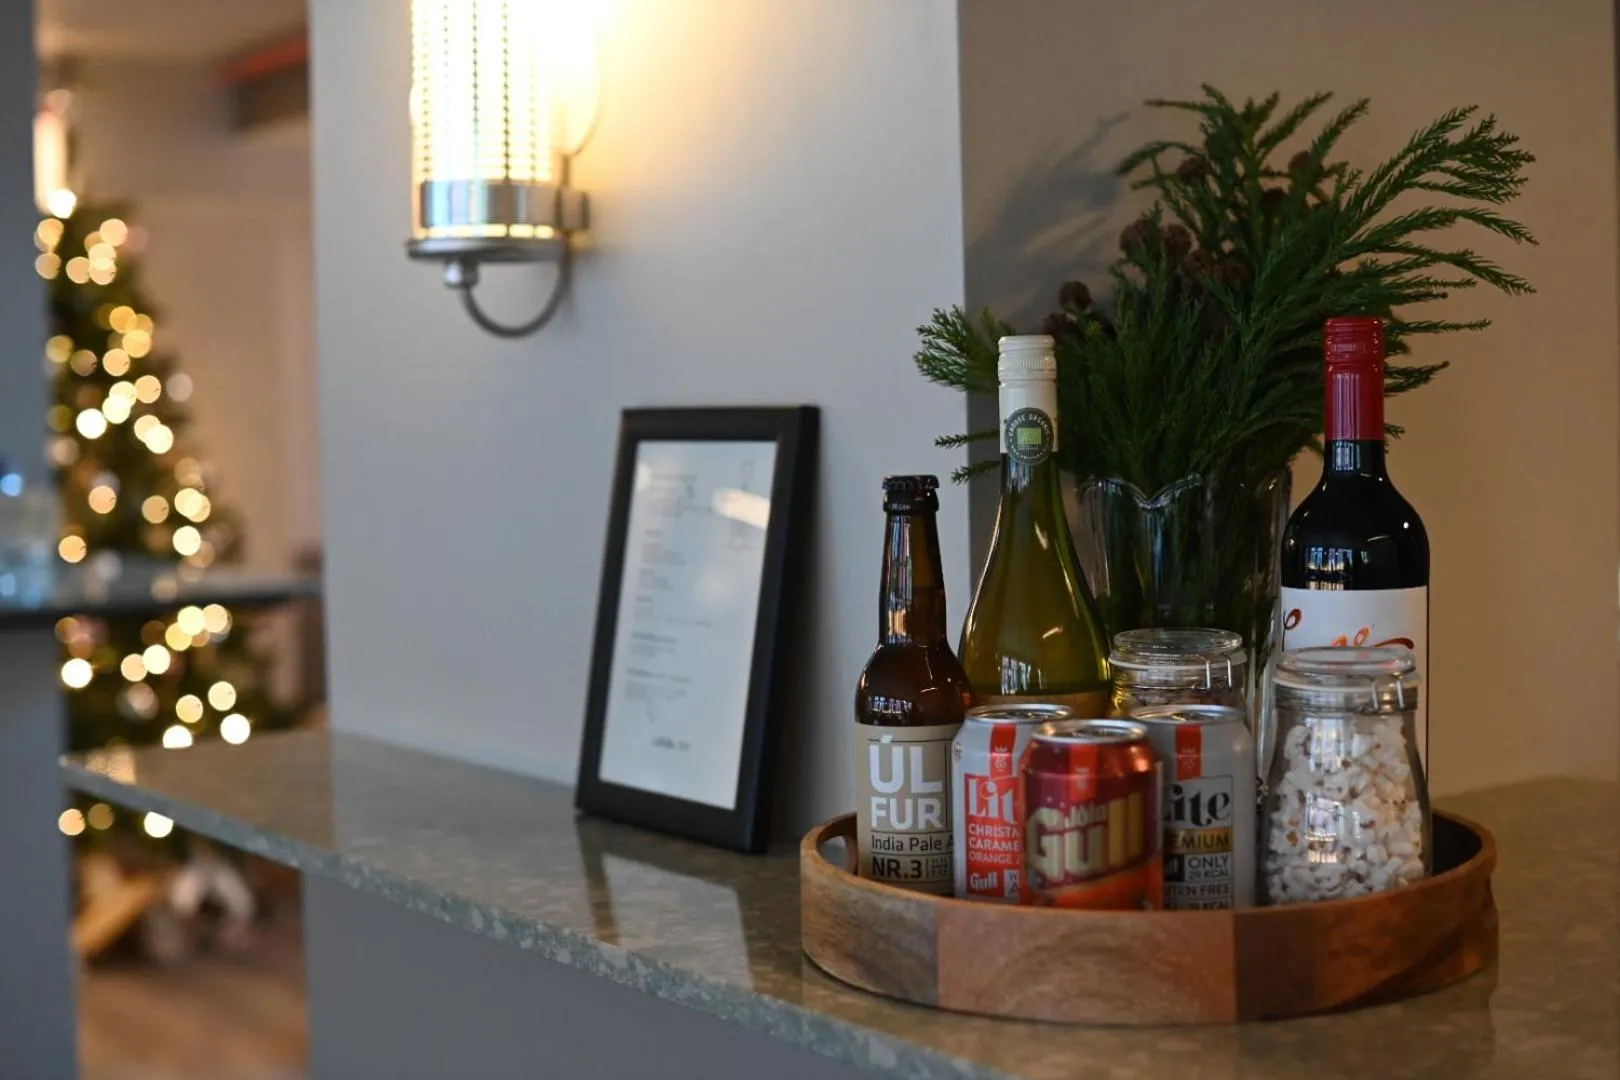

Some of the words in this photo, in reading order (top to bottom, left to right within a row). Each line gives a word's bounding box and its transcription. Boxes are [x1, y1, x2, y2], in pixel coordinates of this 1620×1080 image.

[869, 735, 943, 793] ÚL
[871, 796, 944, 830] FUR
[871, 834, 904, 851] India
[909, 836, 942, 851] Pale
[1026, 791, 1144, 882] Gull
[872, 856, 922, 879] NR.3
[1188, 855, 1228, 869] ONLY
